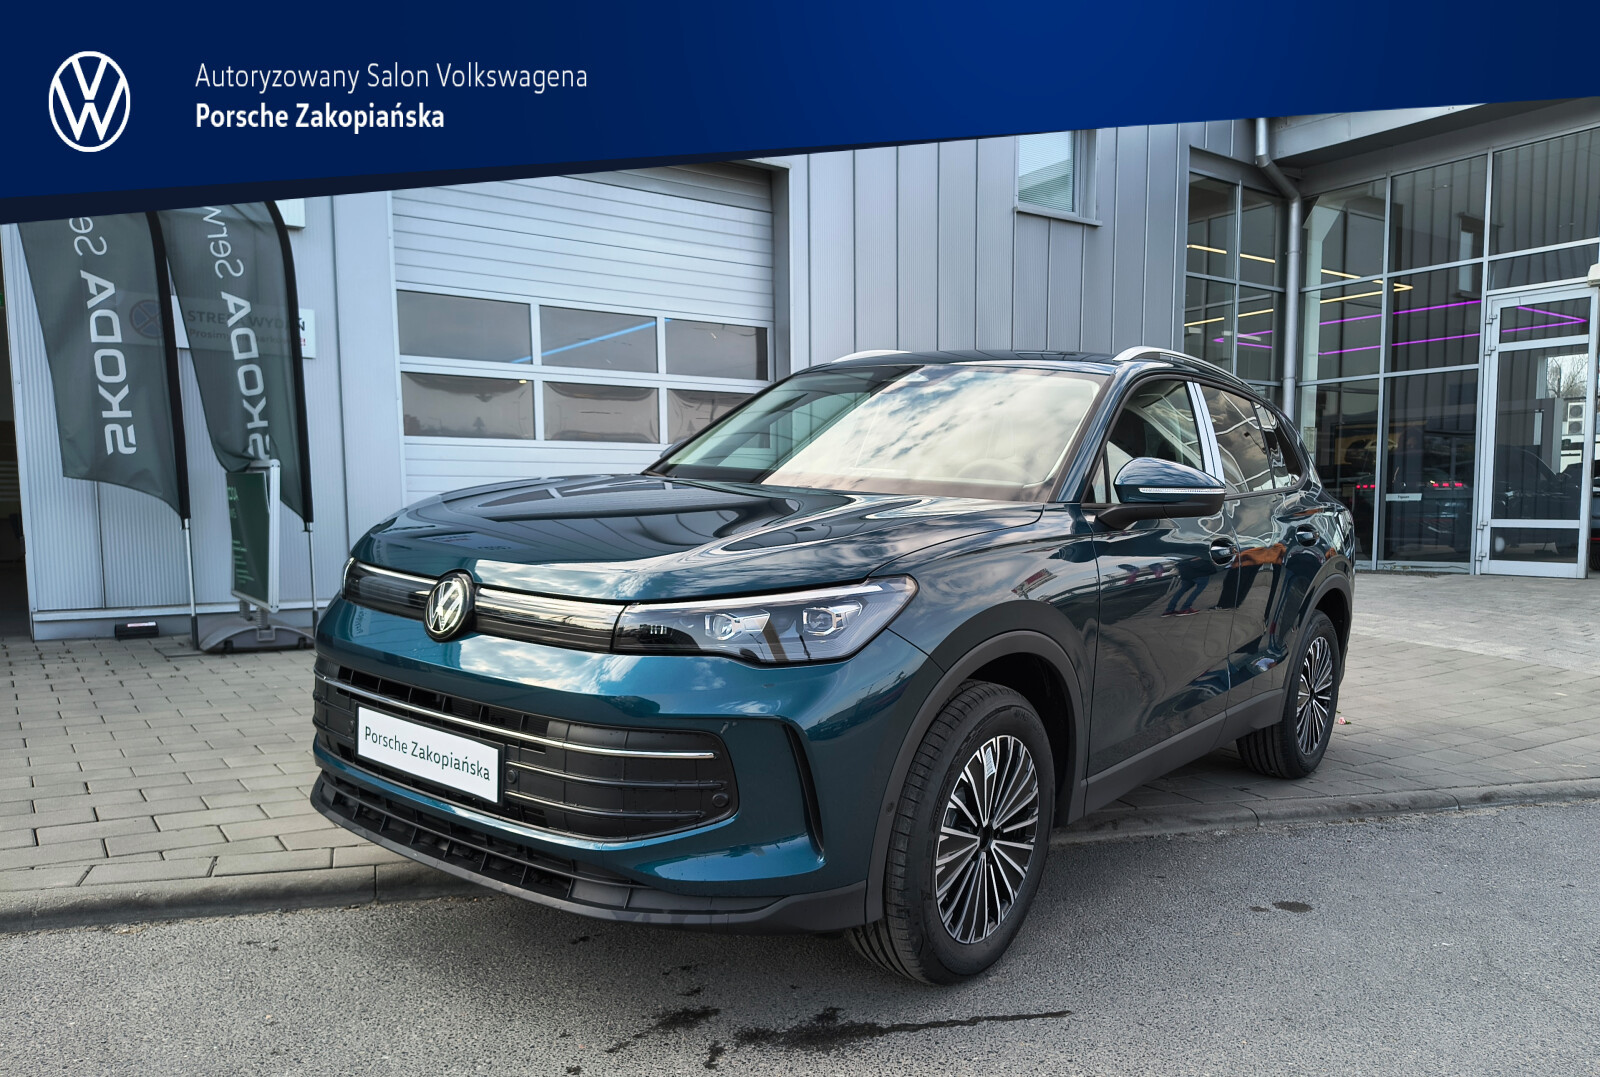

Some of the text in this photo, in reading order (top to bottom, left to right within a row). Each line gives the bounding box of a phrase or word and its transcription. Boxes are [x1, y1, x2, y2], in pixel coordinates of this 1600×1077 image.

[187, 310, 246, 325] STRE
[365, 726, 490, 781] Porsche Zakopiańska
